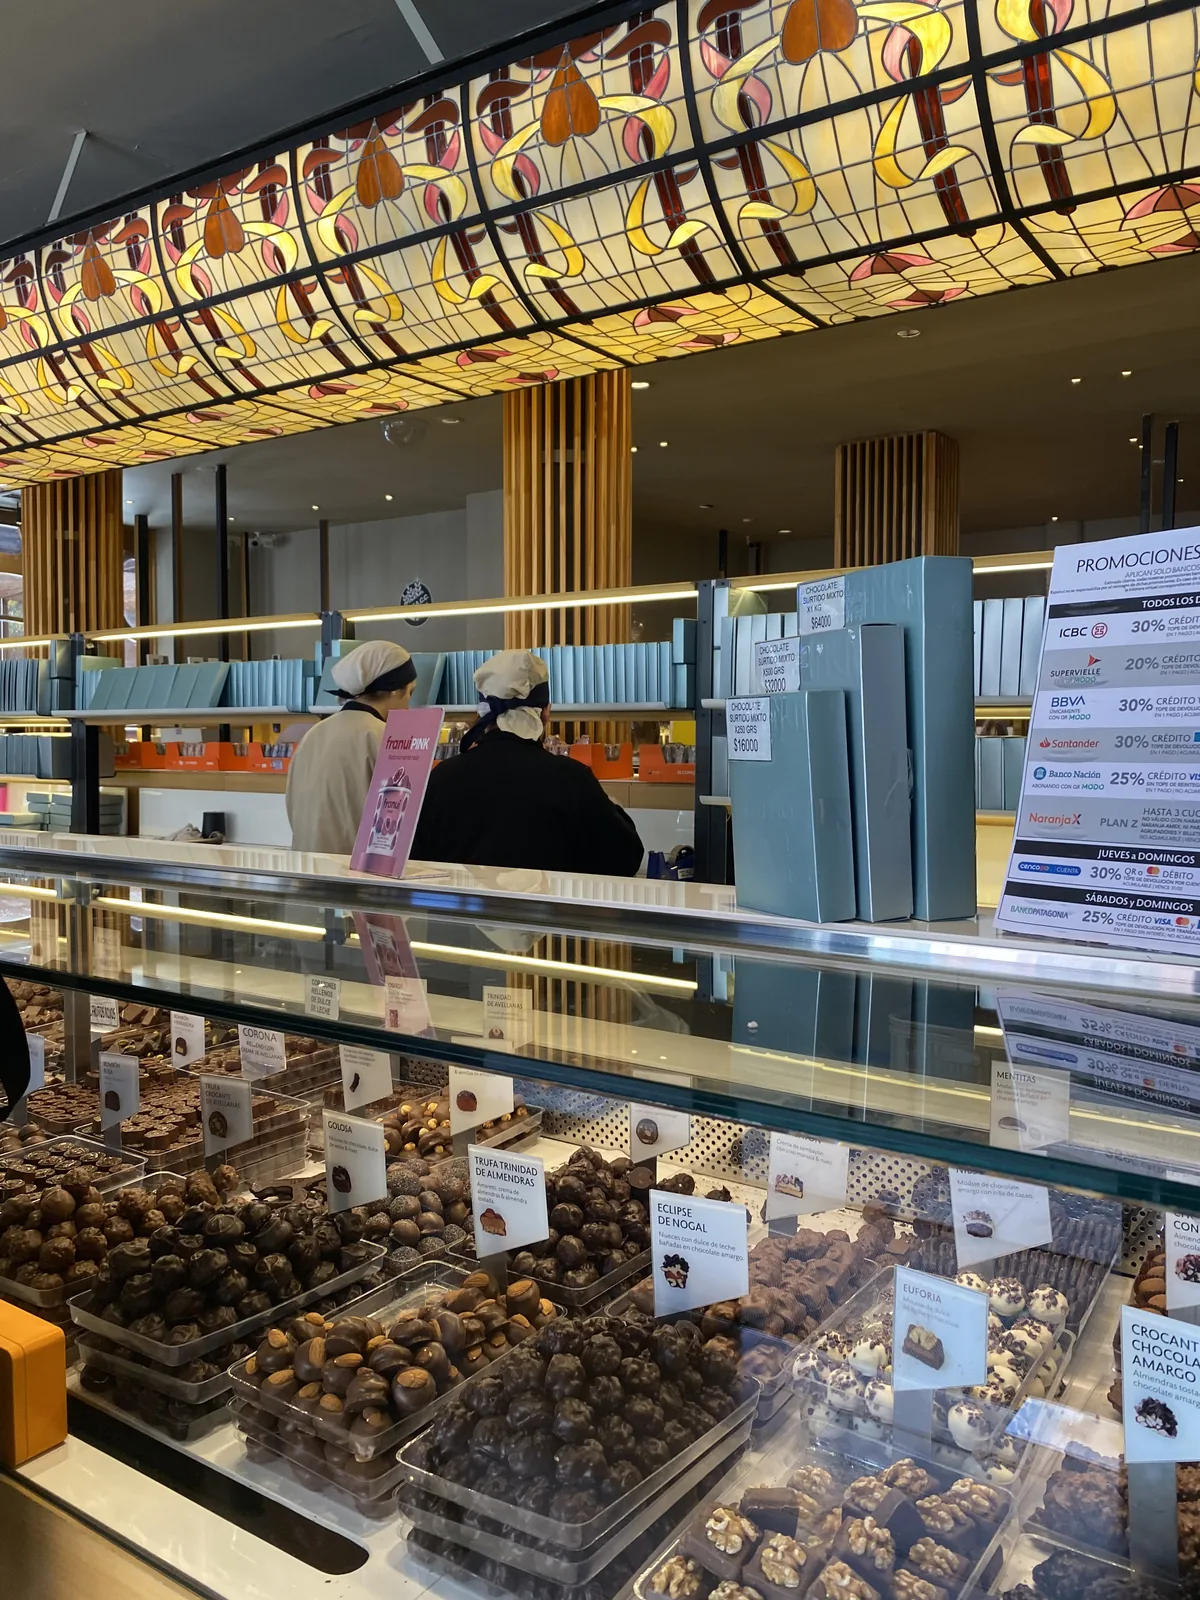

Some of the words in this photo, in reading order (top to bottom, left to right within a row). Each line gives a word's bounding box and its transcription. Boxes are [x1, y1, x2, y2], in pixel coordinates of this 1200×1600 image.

[1076, 544, 1200, 573] PROMOCIONES
[1125, 570, 1152, 578] APLICAN
[1153, 568, 1171, 576] SOLO
[1172, 564, 1200, 574] BANCOS
[806, 582, 838, 594] CHOCOLATE
[803, 594, 826, 604] SURTIDO
[826, 590, 844, 601] MIXTO
[1142, 597, 1175, 608] TODOS
[1176, 595, 1194, 606] LOS
[811, 615, 832, 630] $64000
[1131, 618, 1165, 633] 30%
[1060, 627, 1088, 638] ICBC
[760, 643, 789, 655] CHOCOLATE
[758, 655, 778, 666] SURTIDO
[778, 652, 795, 662] MIXTO
[1125, 656, 1159, 670] 20%
[1162, 654, 1200, 663] CRÉDITO
[763, 666, 774, 676] X500
[774, 666, 784, 675] GRS
[1050, 667, 1101, 678] SUPERVIELLE
[764, 678, 786, 692] $32000
[732, 702, 760, 712] CHOCOLATE
[1051, 696, 1086, 708] BBVA
[1119, 698, 1153, 712] 30%
[1156, 696, 1196, 705] CRÉDITO
[730, 714, 750, 722] SURTIDO
[750, 713, 766, 722] MIXTO
[734, 738, 758, 752] $16000
[1052, 739, 1100, 748] Santander
[1114, 734, 1149, 748] 30%
[1152, 733, 1191, 742] CRÉDITO
[1049, 770, 1072, 778] Banco
[1073, 770, 1101, 779] Nación
[1110, 772, 1144, 786] 25%
[1148, 770, 1186, 780] CRÉDITO
[1143, 808, 1172, 816] HASTA
[1100, 818, 1128, 828] PLAN
[1131, 820, 1138, 828] Z
[1097, 849, 1130, 860] JUEVES
[1138, 852, 1195, 864] DOMINGOS
[1090, 866, 1122, 880] 30%
[1124, 868, 1136, 876] QR
[1162, 870, 1194, 880] DÉBITO
[1085, 892, 1128, 906] SÁBADOS
[1136, 899, 1194, 912] DOMINGOS
[1010, 906, 1068, 919] BANCOPATAGONIA
[1082, 910, 1114, 924] 25%
[1116, 912, 1152, 924] CRÉDITO
[311, 988, 333, 998] RELLENOS
[317, 998, 331, 1006] DULCE
[494, 1001, 522, 1010] AVELLANAS
[317, 1004, 330, 1015] LECHE
[242, 1028, 278, 1042] CORONA
[997, 1071, 1036, 1084] MENTITAS
[205, 1091, 231, 1100] CROCANTE
[328, 1120, 352, 1134] GOLOSA
[776, 1138, 792, 1148] Crema
[475, 1156, 498, 1168] TRUFA
[500, 1161, 538, 1176] TRINIDAD
[476, 1168, 486, 1176] DE
[487, 1170, 534, 1187] ALMENDRAS
[990, 1181, 1020, 1190] chocolate
[478, 1189, 500, 1198] almendras
[506, 1194, 528, 1204] almendra
[658, 1203, 692, 1218] ECLIPSE
[658, 1216, 670, 1226] DE
[672, 1218, 708, 1233] NOGAL
[659, 1231, 680, 1241] Nueces
[693, 1238, 710, 1246] dulce
[720, 1242, 736, 1252] leche
[659, 1239, 682, 1249] bañadas
[691, 1246, 720, 1257] chocolate
[904, 1284, 942, 1304] EUFORIA
[926, 1304, 933, 1312] de
[1132, 1355, 1196, 1383] AMARGO
[1133, 1370, 1178, 1390] Almendras
[1133, 1380, 1173, 1398] chocolate
